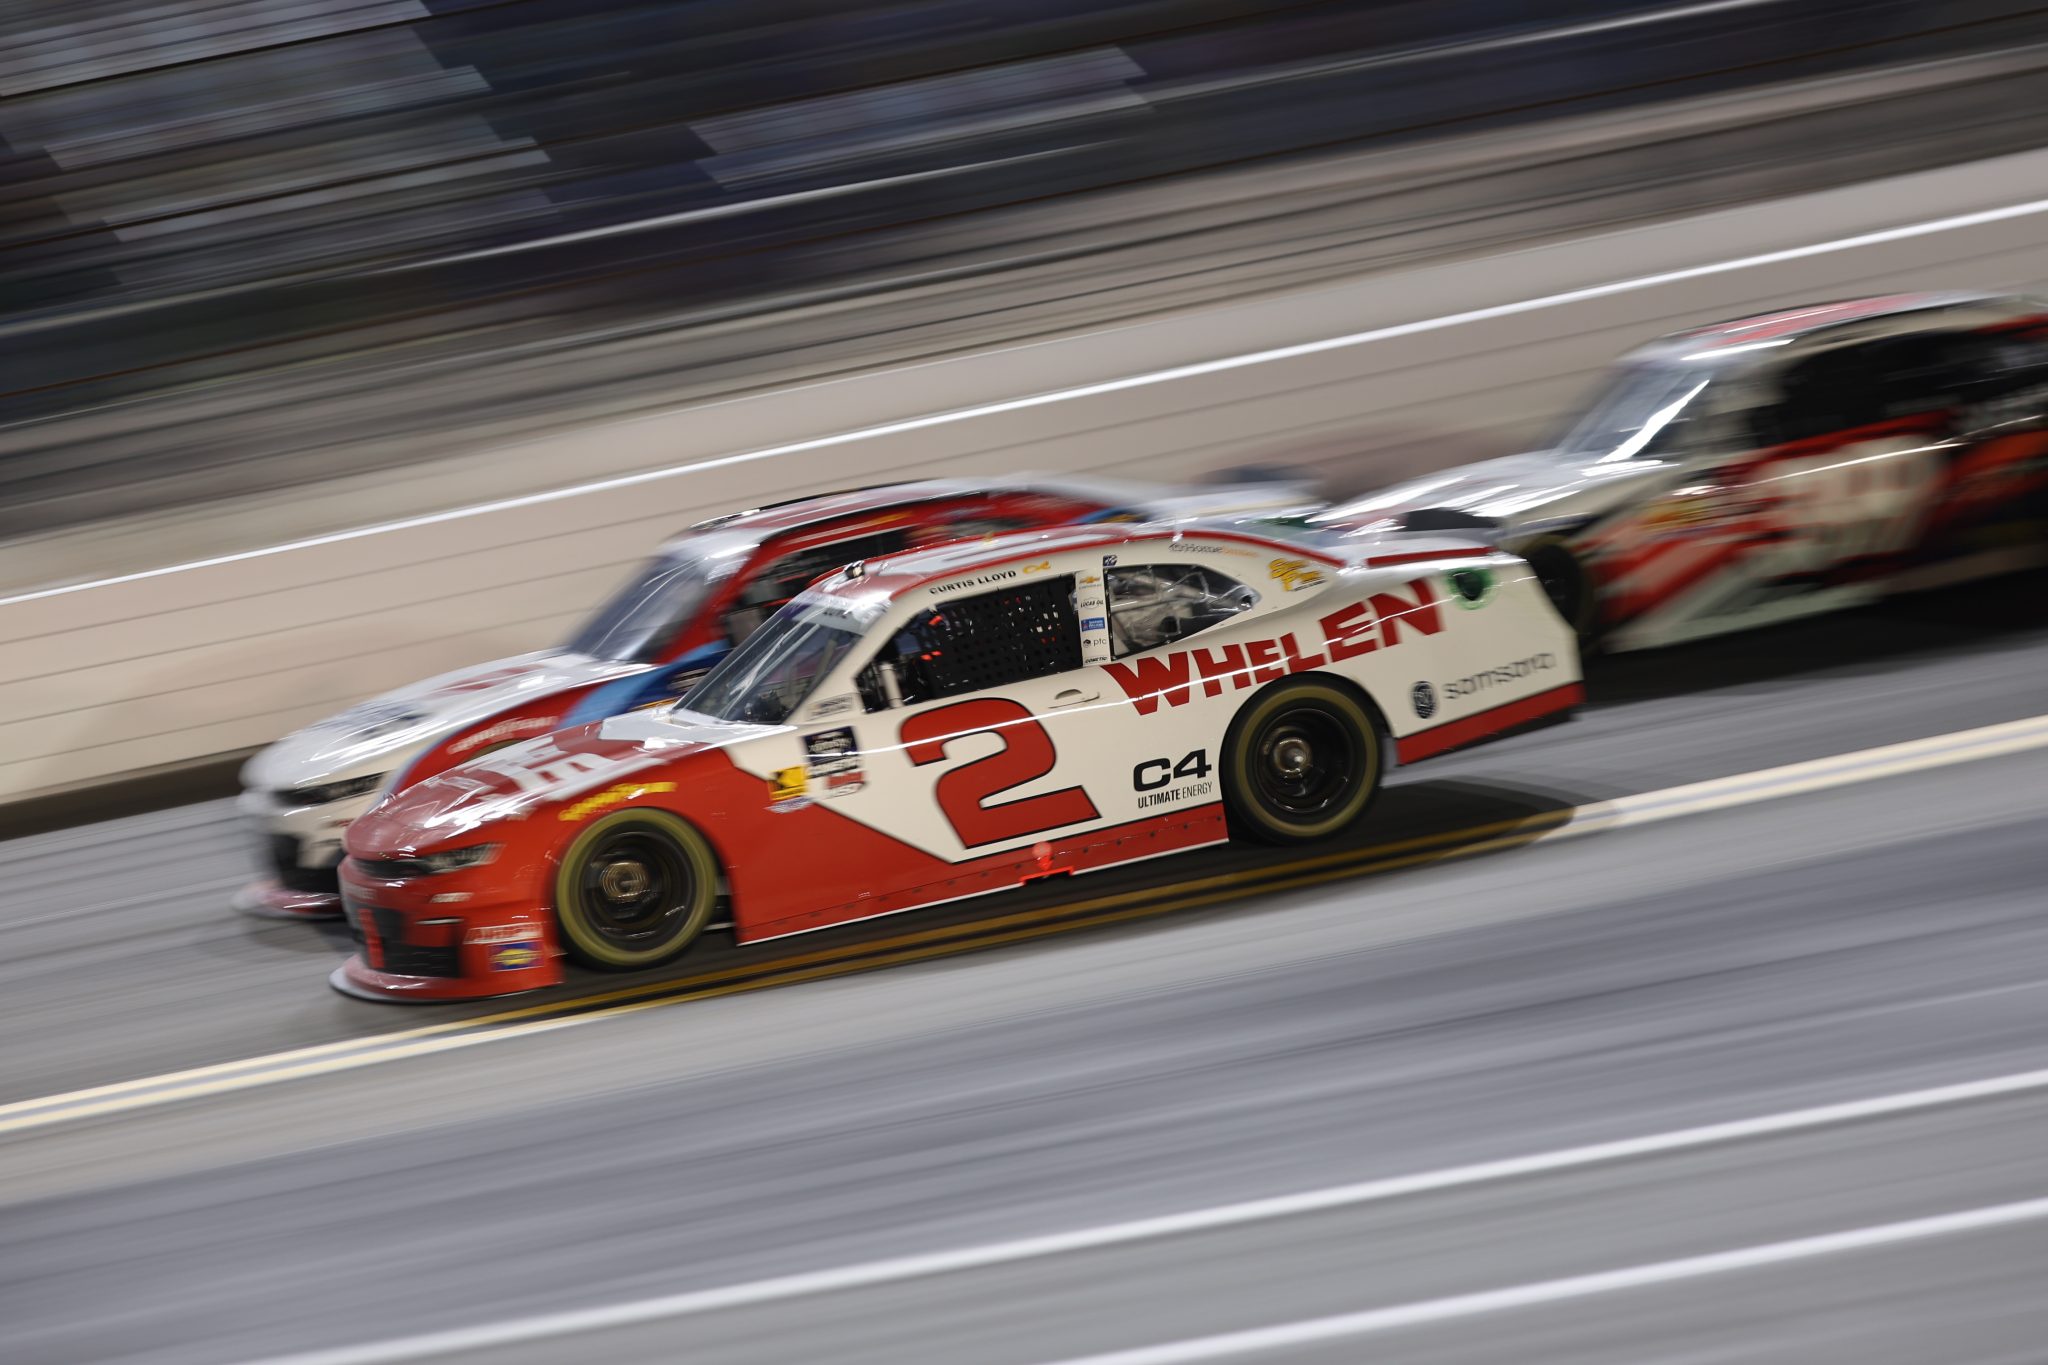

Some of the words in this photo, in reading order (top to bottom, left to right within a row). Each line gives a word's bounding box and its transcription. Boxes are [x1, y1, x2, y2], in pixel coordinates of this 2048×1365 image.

[929, 579, 975, 595] CURTIS
[978, 570, 1017, 585] LLOYD
[1080, 600, 1096, 608] LUCAS
[1093, 638, 1107, 647] ptc
[1100, 576, 1446, 716] WHELEN
[898, 697, 1102, 850] 2
[1133, 748, 1212, 792] C4
[1137, 788, 1181, 809] ULTIMATE
[1182, 781, 1213, 799] ENERGY
